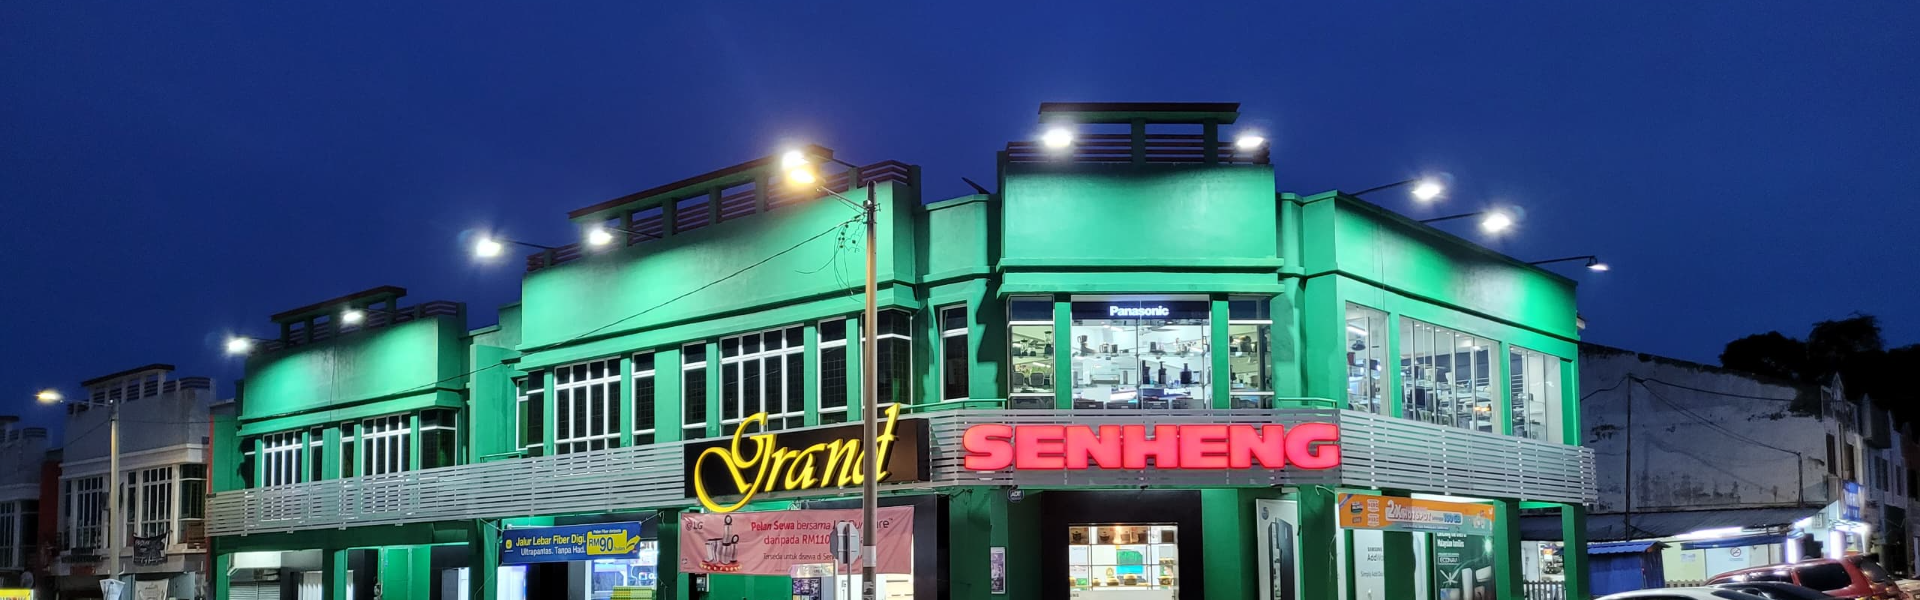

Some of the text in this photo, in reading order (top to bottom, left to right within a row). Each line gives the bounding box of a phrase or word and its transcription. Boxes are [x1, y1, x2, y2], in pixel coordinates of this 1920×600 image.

[1109, 305, 1170, 316] Panasonic
[963, 422, 1340, 470] SENHENG
[695, 402, 900, 513] Grand
[693, 521, 704, 530] LG
[751, 521, 772, 532] Pelan
[773, 520, 795, 531] Sewa
[796, 519, 831, 530] bersama
[516, 532, 586, 547] Jalur Lebar Fiber Digi.
[764, 534, 830, 546] daripada RM110
[521, 546, 554, 556] Ultrapantas.
[555, 546, 572, 555] Tanpa
[763, 553, 783, 561] Tersedia
[784, 552, 797, 560] untuk
[799, 552, 816, 560] disewa
[817, 552, 822, 560] di
